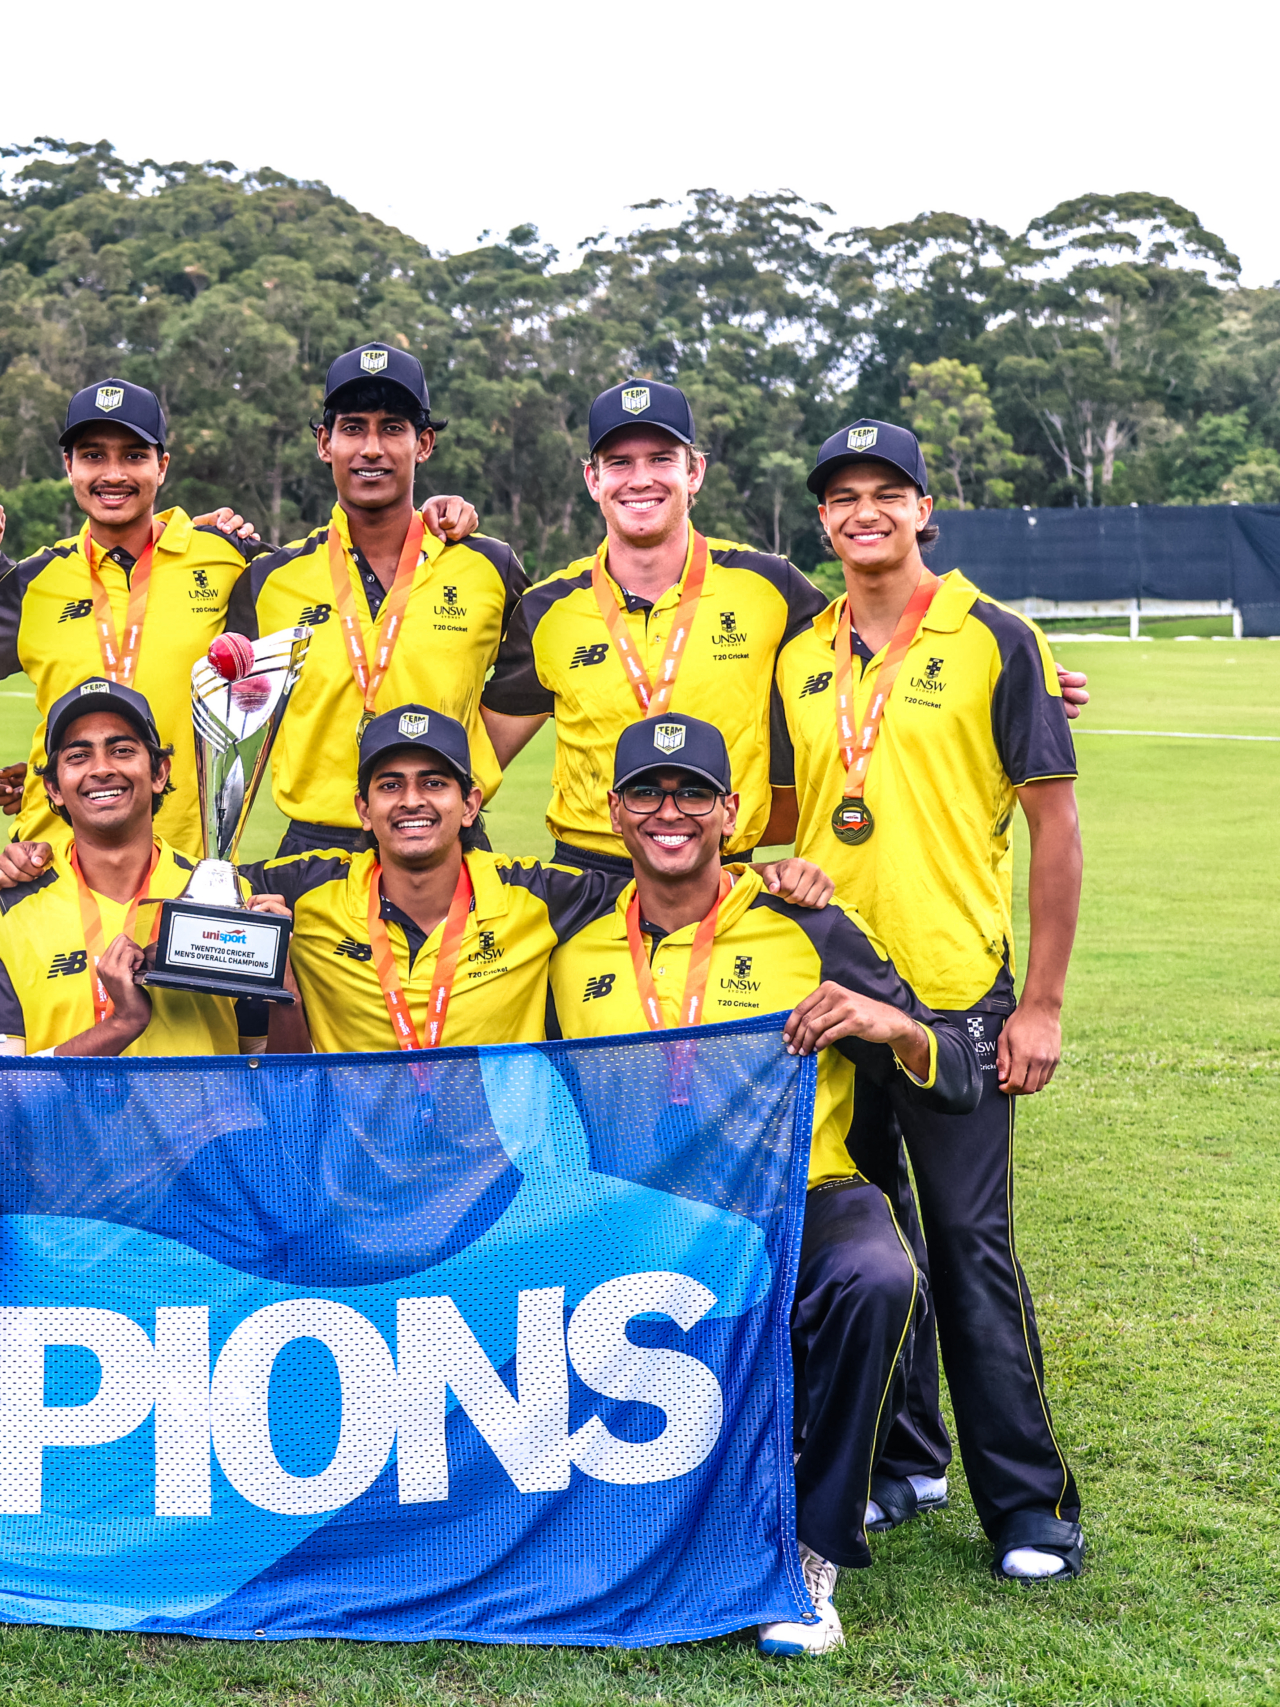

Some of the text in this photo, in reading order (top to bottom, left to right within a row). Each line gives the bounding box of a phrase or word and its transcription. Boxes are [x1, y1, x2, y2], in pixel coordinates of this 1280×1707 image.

[364, 352, 384, 360] TEAM
[624, 390, 646, 398] TEAM
[188, 588, 219, 599] UNSW
[433, 605, 467, 616] UNSW
[712, 633, 747, 645] UNSW
[910, 677, 947, 692] UNSW
[904, 696, 942, 709] T20 Cricket
[403, 714, 426, 723] TEAM
[658, 726, 682, 736] TEAM
[202, 930, 247, 944] unisport
[190, 943, 255, 959] TWENTY20 CRICKET
[468, 948, 505, 962] UNSW
[174, 949, 269, 969] MEN'S OVERALL CHAMPIONS
[468, 971, 482, 979] T20
[720, 978, 761, 992] UNSW
[717, 999, 760, 1009] T20 Cricket
[975, 1041, 996, 1053] NSW
